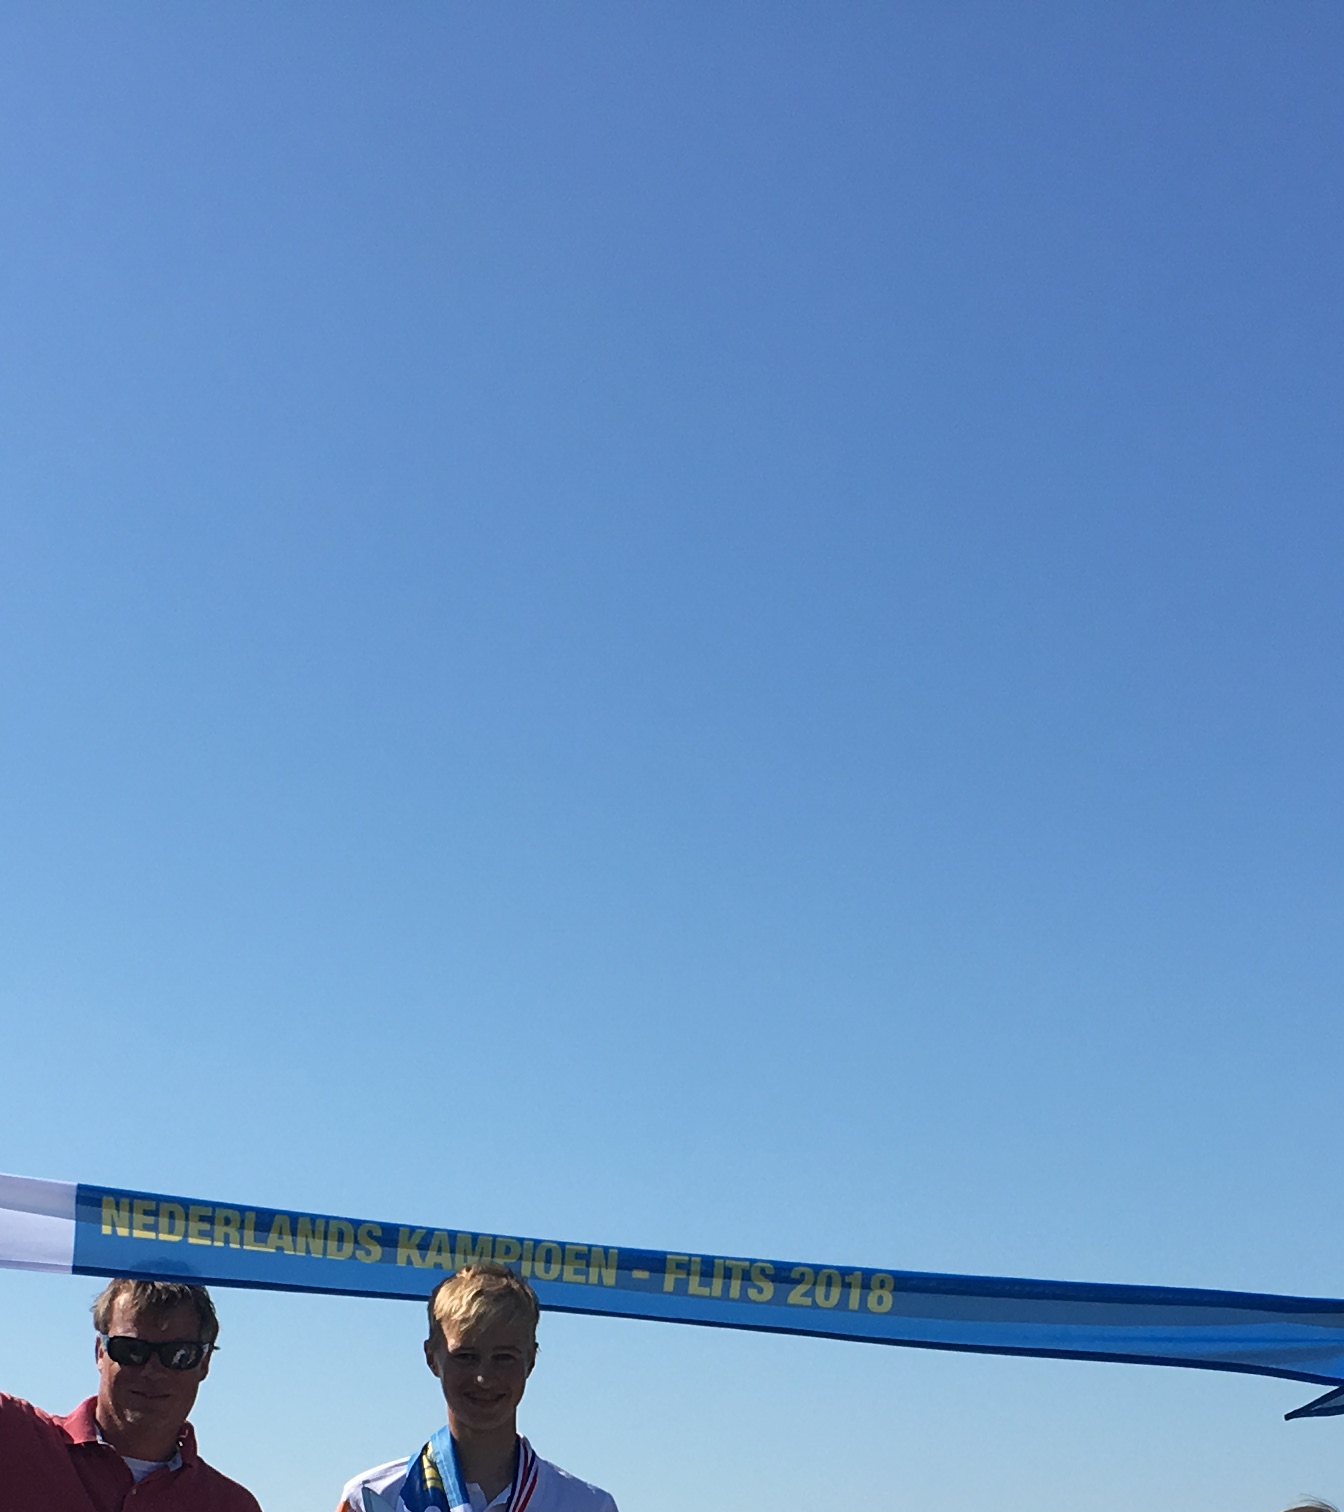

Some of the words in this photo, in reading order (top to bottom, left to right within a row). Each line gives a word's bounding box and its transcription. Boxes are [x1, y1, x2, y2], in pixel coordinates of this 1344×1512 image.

[101, 1196, 383, 1263] NEDERLANDS
[395, 1226, 617, 1287] KAMPIOEN
[662, 1255, 776, 1304] FLITS
[786, 1266, 895, 1314] 2018
